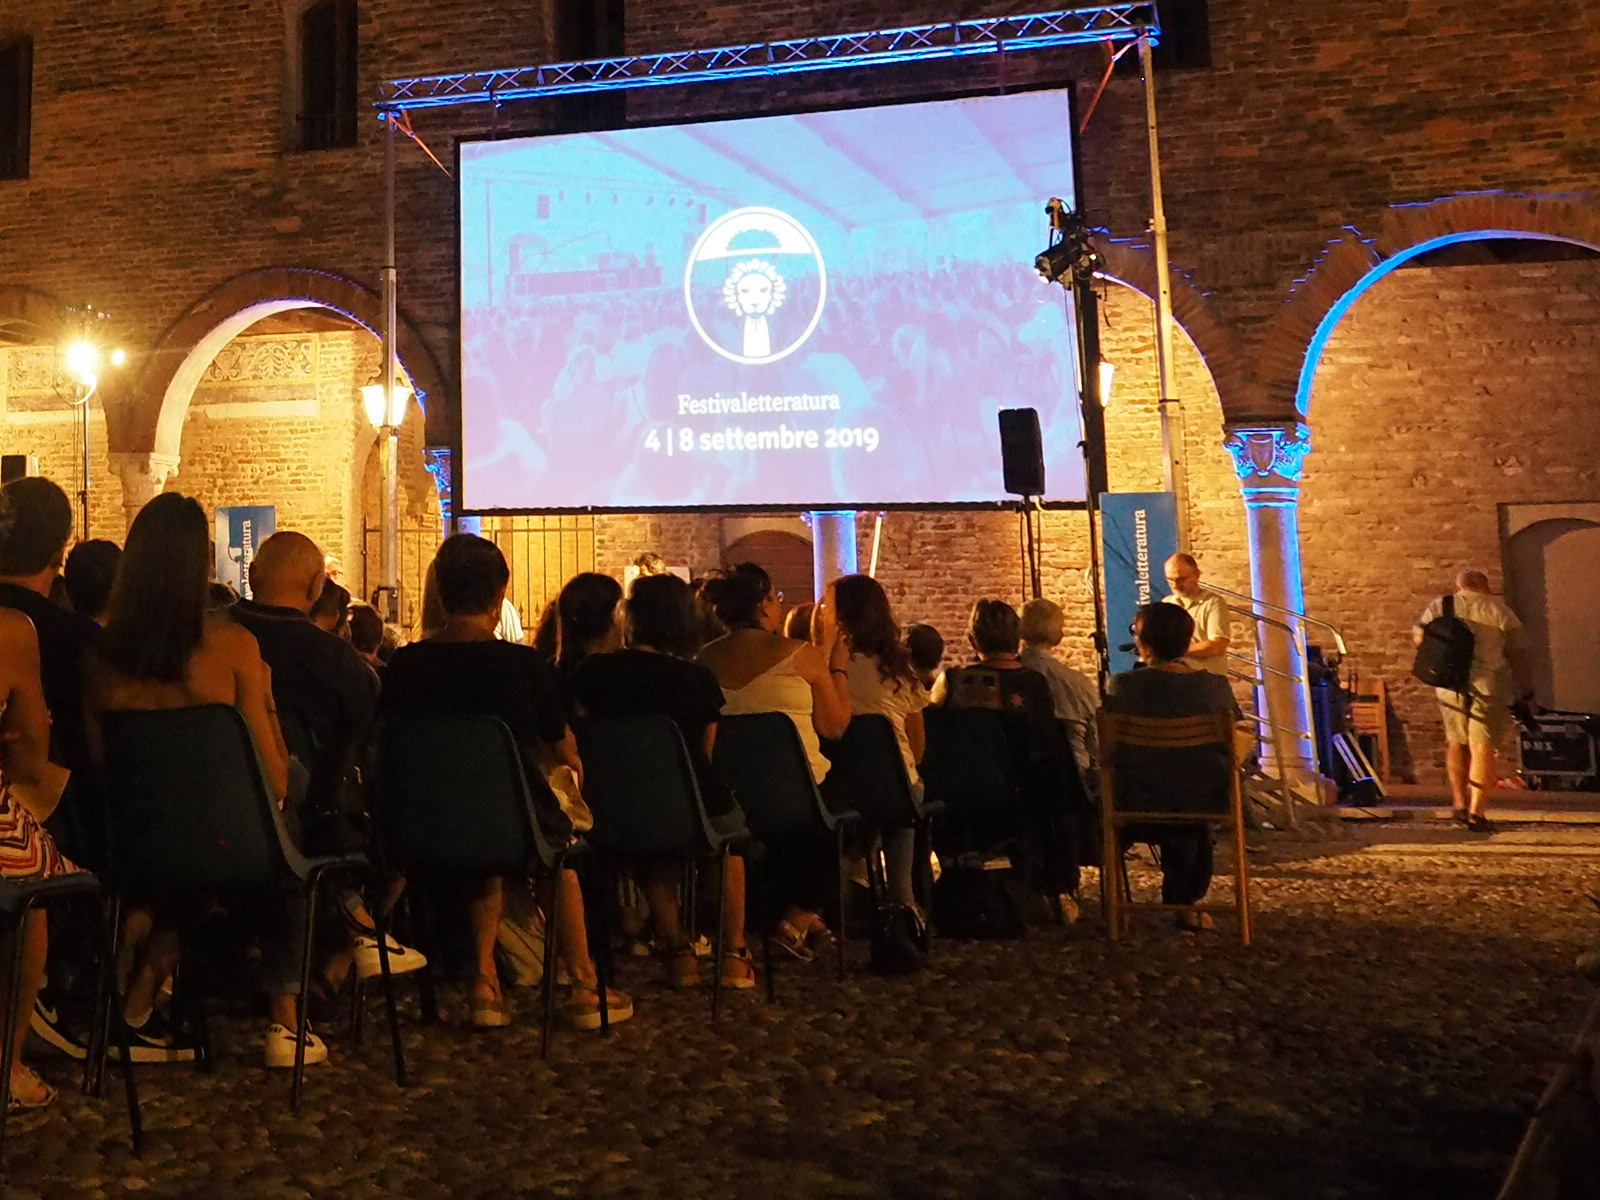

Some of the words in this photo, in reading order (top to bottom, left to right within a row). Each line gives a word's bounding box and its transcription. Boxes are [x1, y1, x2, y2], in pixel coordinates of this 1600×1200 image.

[677, 392, 841, 415] Festivaletteratura
[644, 428, 661, 452] 4
[678, 427, 694, 451] 8
[699, 424, 819, 451] settembre
[823, 427, 880, 452] 2019
[1134, 509, 1150, 605] ivaletteratura
